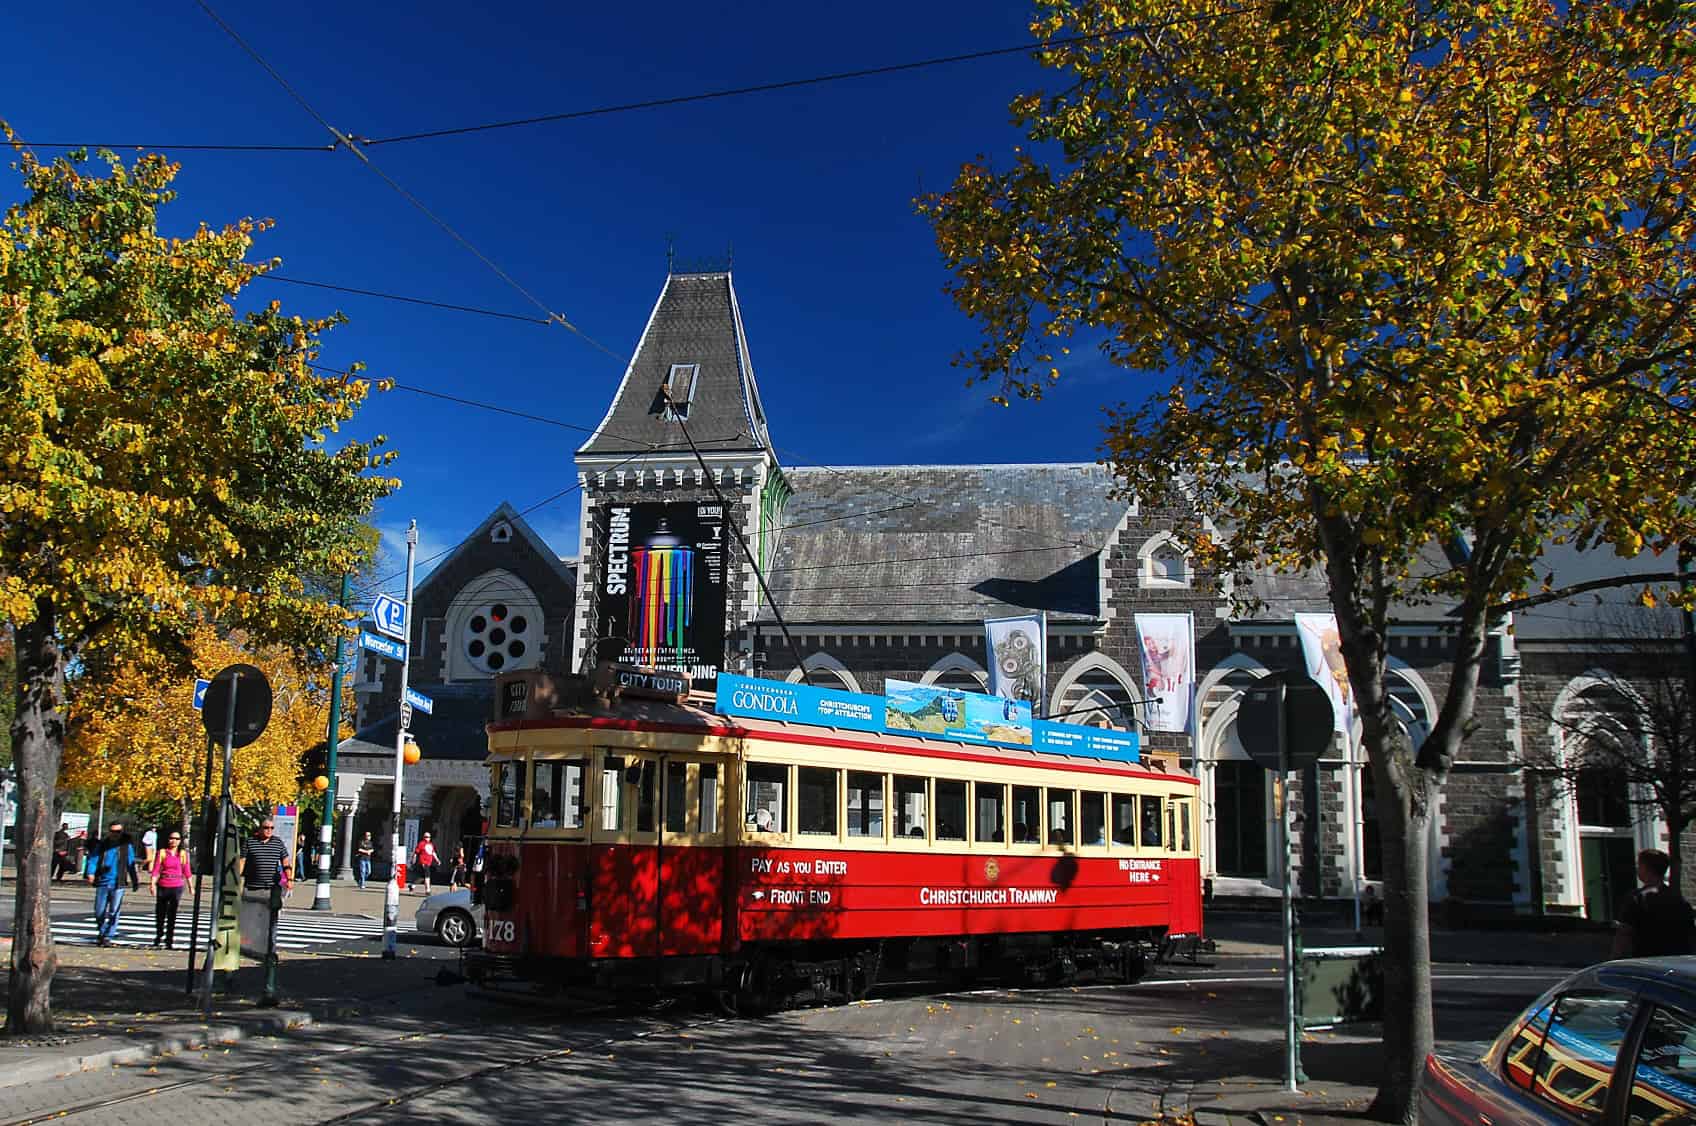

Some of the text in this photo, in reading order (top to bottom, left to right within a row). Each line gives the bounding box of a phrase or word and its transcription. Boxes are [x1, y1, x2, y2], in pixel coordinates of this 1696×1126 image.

[606, 507, 631, 595] SPECTRUM
[391, 603, 400, 623] P
[620, 672, 683, 692] CITY TOUR
[732, 690, 799, 716] GONDOLA
[751, 858, 847, 875] PAY AS YOU ENTER
[1129, 871, 1151, 883] HERE
[770, 889, 831, 904] FRONT END
[920, 887, 1058, 905] CHRISTCHURCH TRAMWAY
[488, 919, 515, 942] 178
